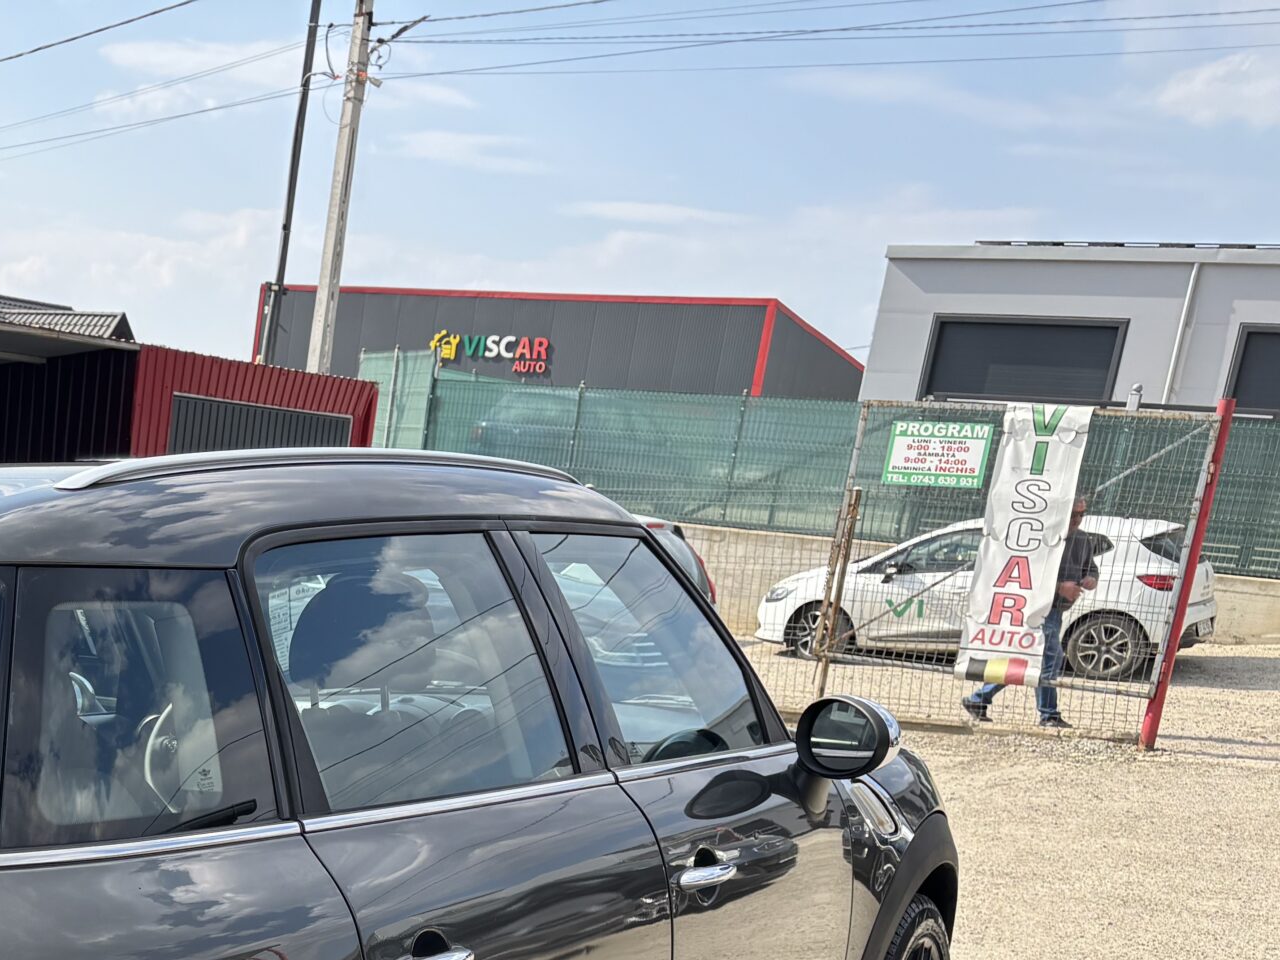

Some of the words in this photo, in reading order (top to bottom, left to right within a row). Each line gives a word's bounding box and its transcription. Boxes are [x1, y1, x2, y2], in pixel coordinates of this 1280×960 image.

[464, 335, 549, 360] VISCAR
[512, 361, 546, 373] AUTO
[895, 422, 990, 439] PROGRAM
[906, 444, 930, 452] 9:00
[940, 445, 970, 453] 18:00
[904, 456, 927, 464] 9:00
[937, 458, 968, 466] 14:00
[886, 473, 908, 483] TEL:
[911, 475, 935, 484] 0743
[937, 476, 957, 485] 639
[960, 477, 979, 486] 931
[969, 628, 1037, 649] AUTO
